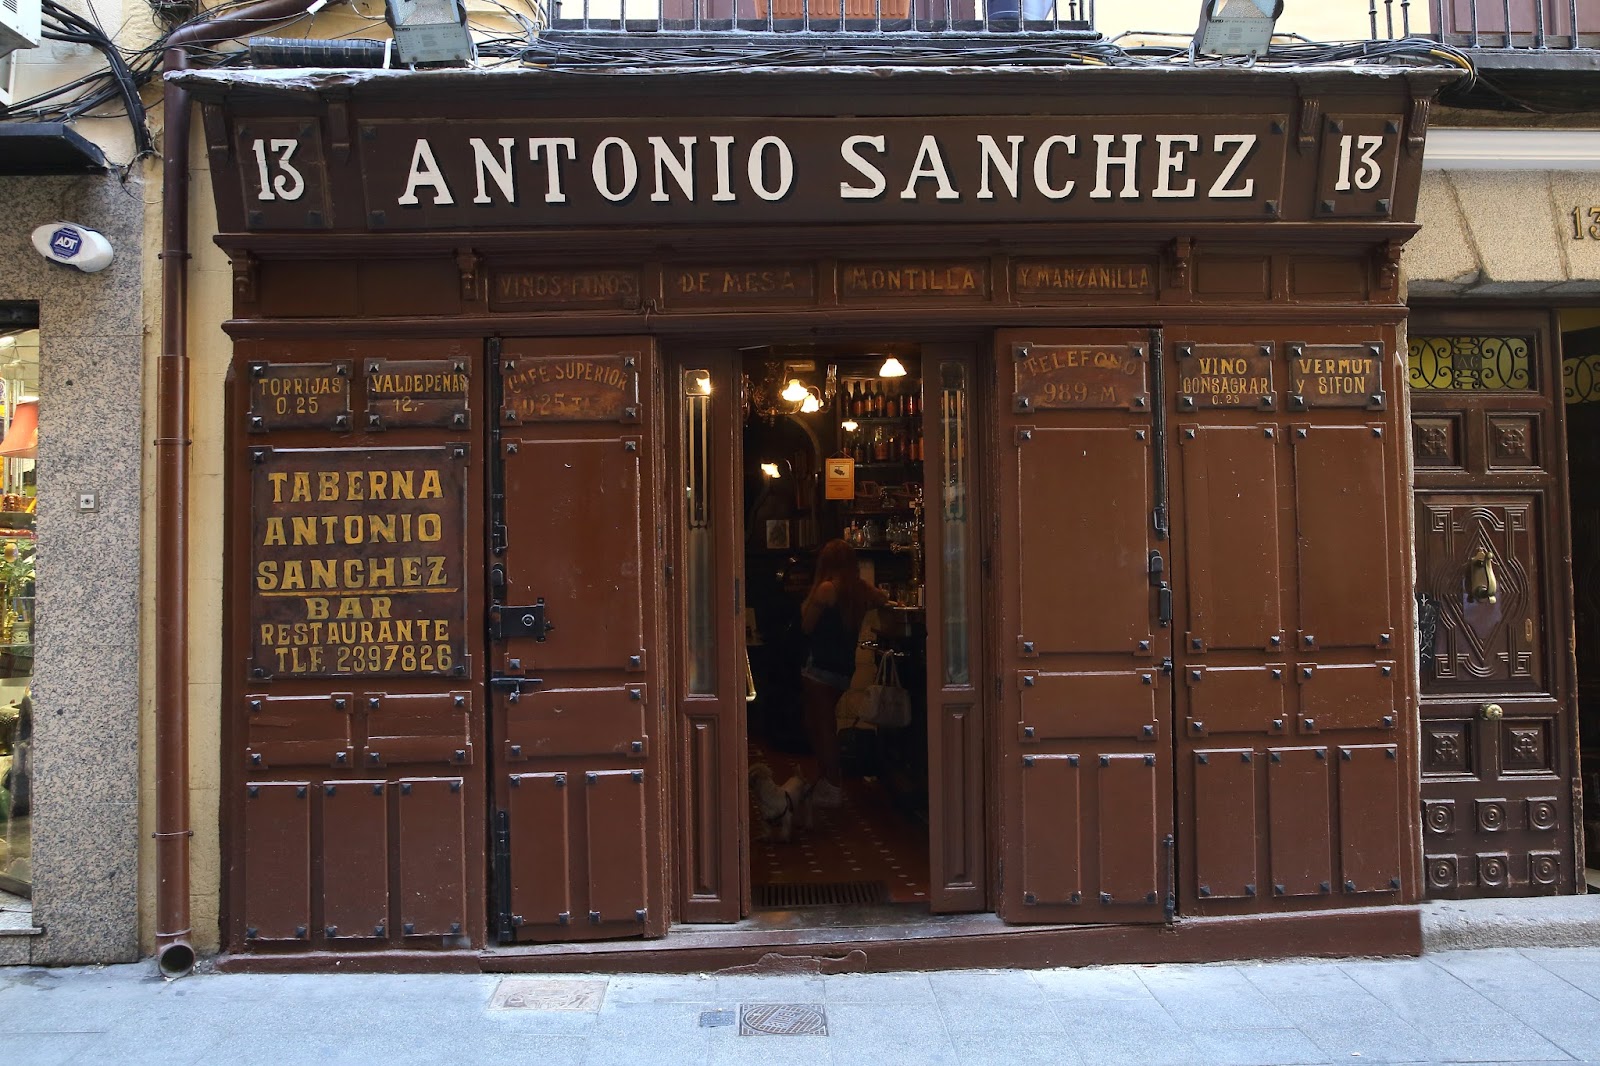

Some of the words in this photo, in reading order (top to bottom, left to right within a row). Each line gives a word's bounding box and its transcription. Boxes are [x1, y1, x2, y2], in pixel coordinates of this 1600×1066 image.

[252, 139, 305, 200] 13
[398, 135, 794, 205] ANTONIO
[840, 134, 1257, 199] SANCHEZ
[1335, 135, 1383, 191] 13
[55, 236, 78, 250] ADT
[681, 271, 711, 293] DE
[722, 270, 795, 293] MESA
[852, 267, 976, 290] MONTILLA
[1021, 268, 1029, 287] Y
[1036, 267, 1149, 289] MANZANILLA
[555, 361, 629, 391] SUPERIOR
[1199, 358, 1247, 375] VINO
[1299, 359, 1373, 374] VERMUT
[259, 377, 341, 396] TORRIJAS
[1318, 376, 1365, 395] SIFON
[268, 470, 444, 504] TABERNA
[263, 513, 442, 546] ANTONIO
[256, 556, 448, 590] SANCHEZ
[305, 596, 392, 620] BAR
[260, 619, 449, 646] RESTAURANTE
[337, 644, 452, 673] 2397826
